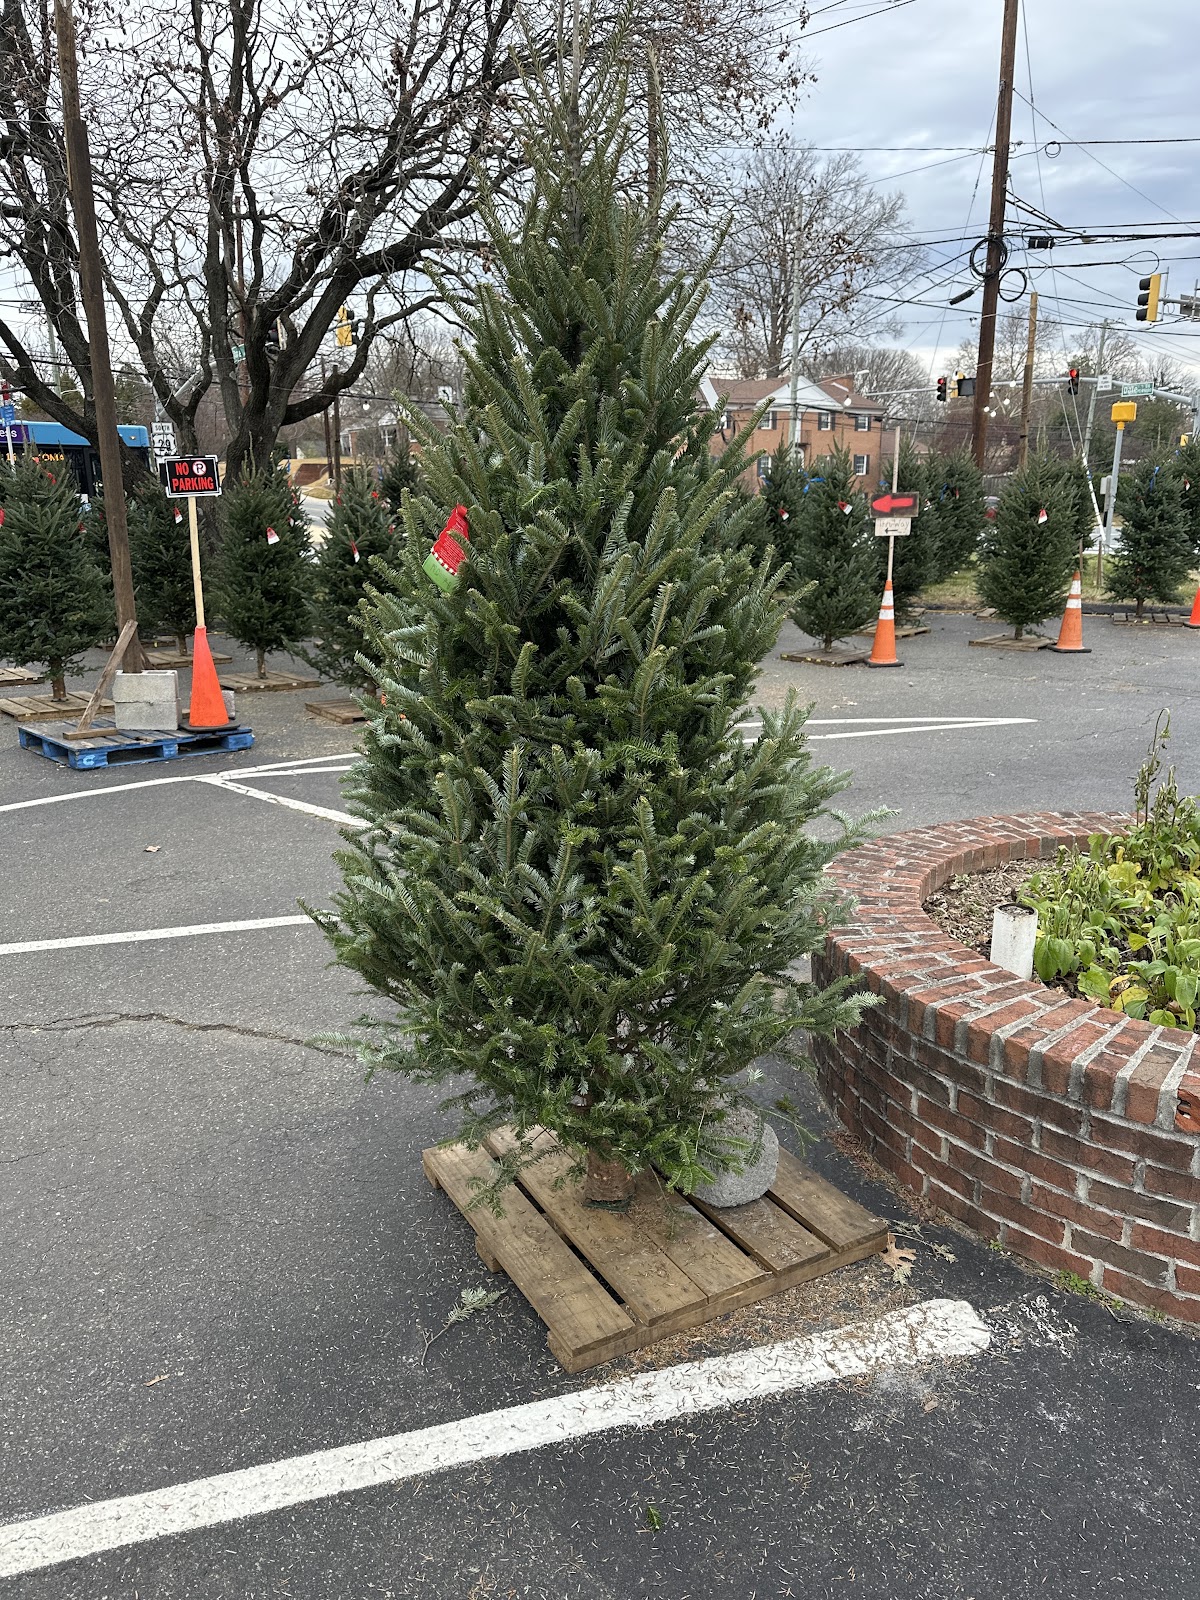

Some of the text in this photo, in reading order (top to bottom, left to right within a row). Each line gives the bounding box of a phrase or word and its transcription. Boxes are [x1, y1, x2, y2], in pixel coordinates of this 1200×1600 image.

[0, 429, 17, 438] es
[158, 439, 171, 452] 29
[175, 462, 189, 476] NO
[171, 476, 215, 492] PARKING
